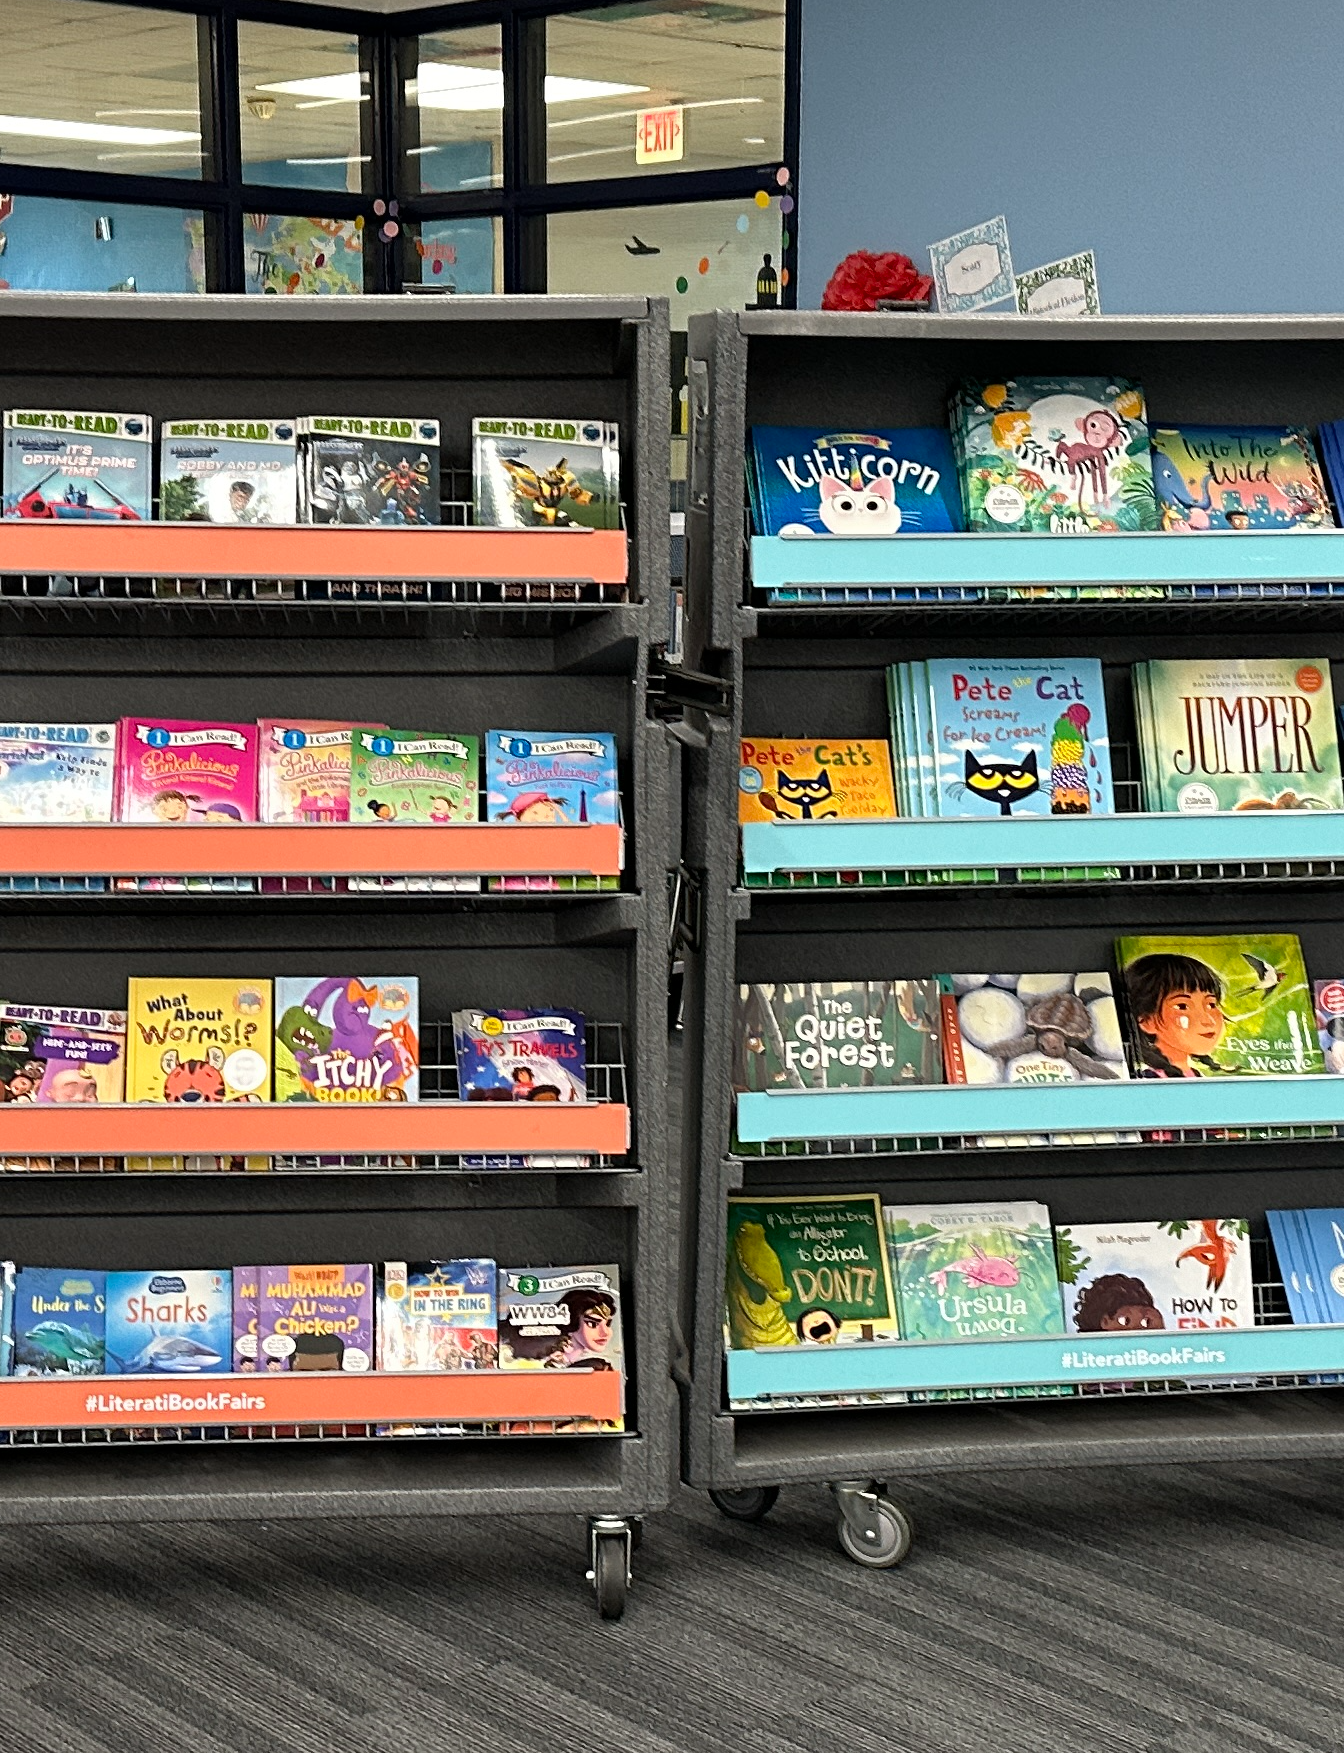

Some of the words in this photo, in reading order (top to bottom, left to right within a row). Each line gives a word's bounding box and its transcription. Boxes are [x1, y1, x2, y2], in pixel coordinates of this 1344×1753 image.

[644, 111, 676, 153] EXIT
[65, 444, 93, 455] IT'S
[1183, 438, 1231, 462] Into
[1236, 434, 1278, 457] The
[91, 456, 136, 469] PRIME
[776, 447, 940, 495] Kitticorn
[1207, 460, 1271, 485] Wild
[952, 674, 1012, 701] Pete
[1012, 675, 1032, 688] the
[1036, 675, 1085, 700] Cat
[962, 706, 1021, 723] Screams
[970, 727, 992, 743] Ice
[994, 724, 1047, 741] Cream!
[1173, 695, 1325, 775] JUMPER
[741, 742, 795, 766] Pete
[814, 744, 873, 766] Cat's
[141, 752, 240, 778] Pinkalicious
[146, 994, 189, 1014] What
[822, 999, 852, 1015] The
[173, 1008, 223, 1022] About
[136, 1021, 257, 1047] Worms!?
[795, 1014, 883, 1042] Quiet
[518, 1040, 578, 1058] TRAVELS
[1226, 1036, 1271, 1053] Eyes
[785, 1041, 895, 1070] Forest
[1248, 1054, 1312, 1072] Weave
[310, 1055, 392, 1089] ITCHY
[1016, 1061, 1040, 1074] One
[1042, 1062, 1067, 1075] Tiny
[266, 1281, 365, 1299] MUHAMMAD
[32, 1296, 72, 1314] Under
[126, 1297, 207, 1323] Sharks
[291, 1302, 317, 1316] ALI
[414, 1299, 427, 1312] IN
[430, 1299, 454, 1312] THE
[458, 1298, 486, 1311] RING
[510, 1305, 568, 1323] WW84
[937, 1295, 1028, 1322] Ursula
[1171, 1296, 1214, 1316] HOW
[1220, 1296, 1238, 1312] TO
[274, 1316, 359, 1335] Chicken?
[1061, 1347, 1226, 1369] #LiteratiBookFairs
[86, 1392, 266, 1413] #LiteratiBookFairs
